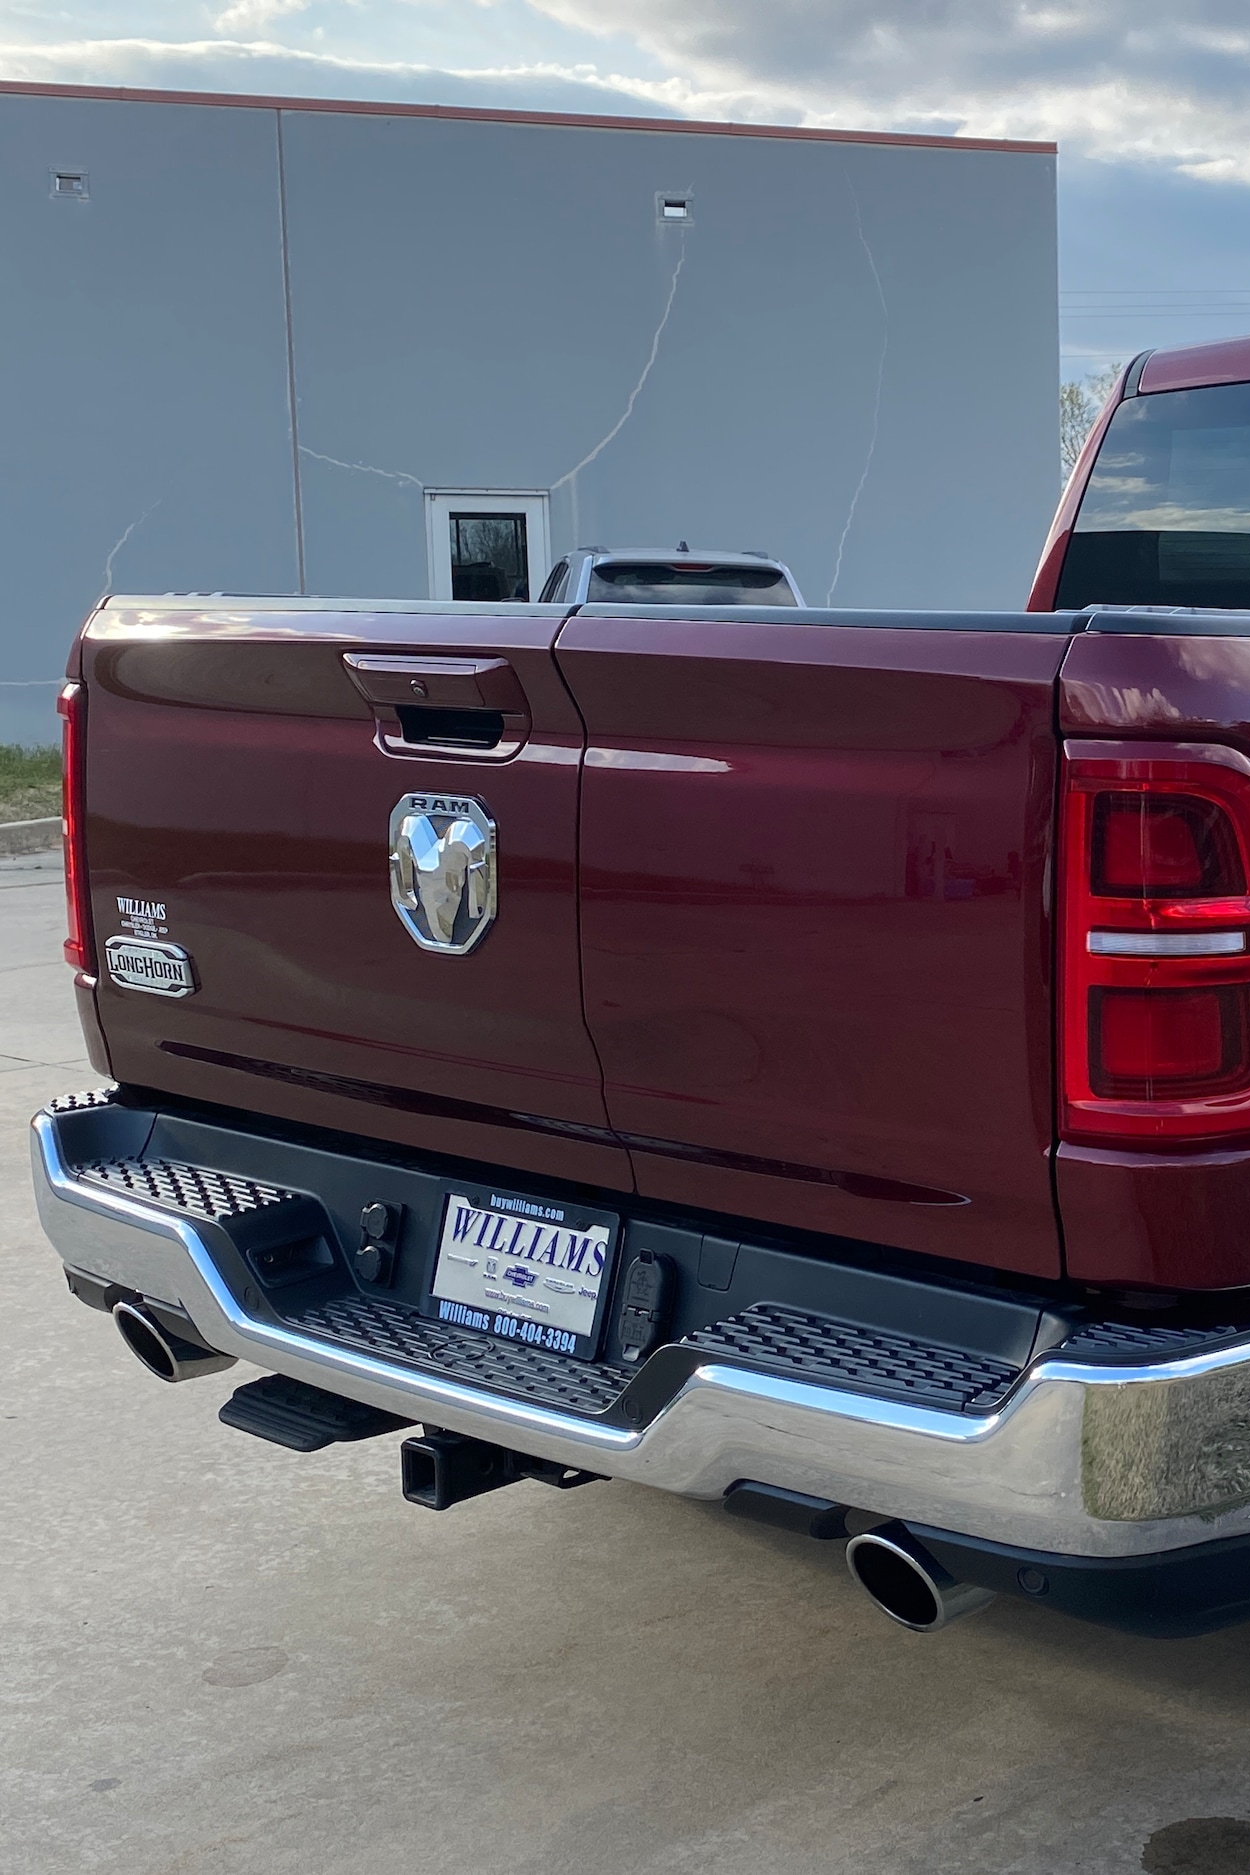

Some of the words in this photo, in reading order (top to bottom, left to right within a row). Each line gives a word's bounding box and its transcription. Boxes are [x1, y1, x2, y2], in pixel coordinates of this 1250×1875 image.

[409, 798, 469, 813] RAM
[116, 896, 166, 920] WILLIAMS
[490, 1194, 564, 1221] buywilliams.com
[452, 1206, 609, 1277] WILLIAMS
[506, 1271, 535, 1282] CHEVROLET
[438, 1300, 489, 1331] Williams
[494, 1317, 577, 1354] 800-404-3394
